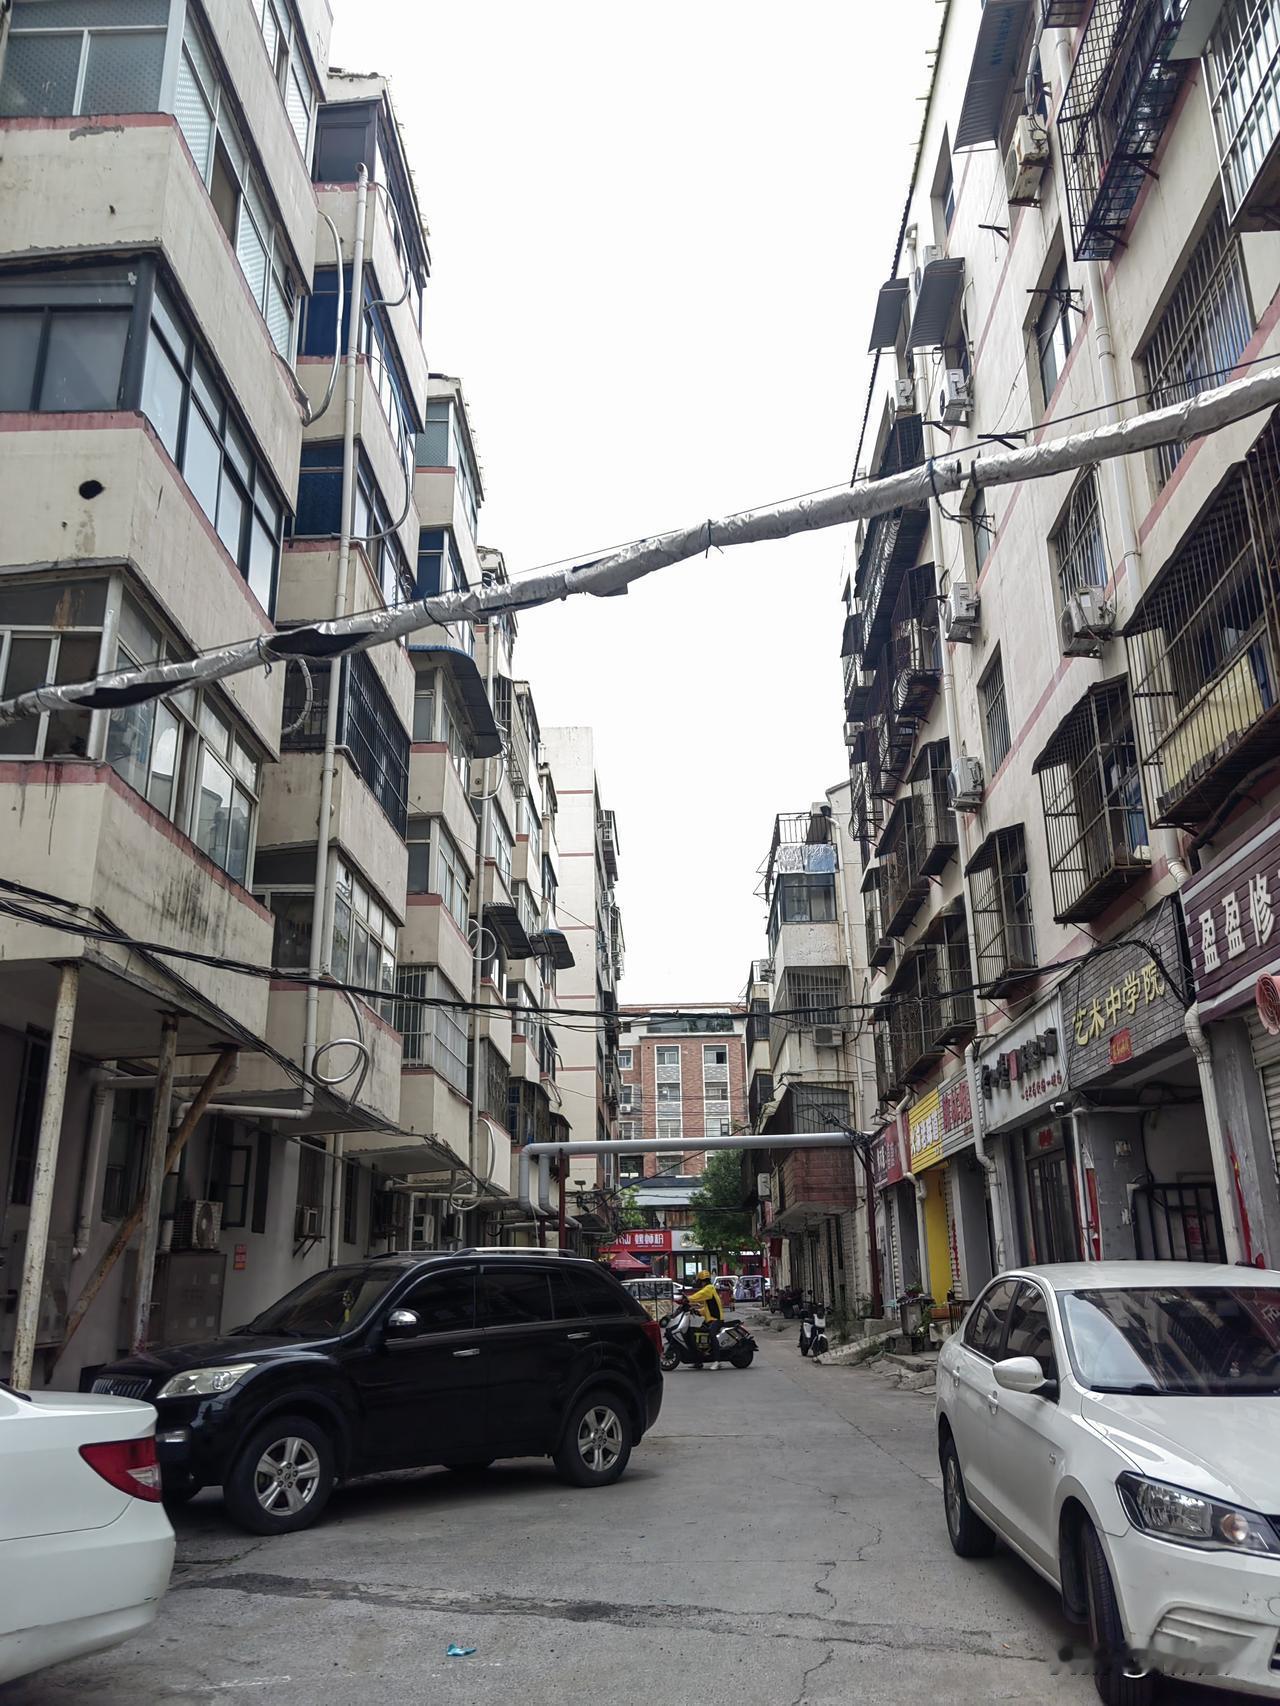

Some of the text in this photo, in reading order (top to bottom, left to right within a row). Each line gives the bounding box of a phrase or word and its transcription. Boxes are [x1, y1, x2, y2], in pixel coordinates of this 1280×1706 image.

[1199, 869, 1280, 973] 盈盈修
[1072, 959, 1165, 1045] 艺术中学院
